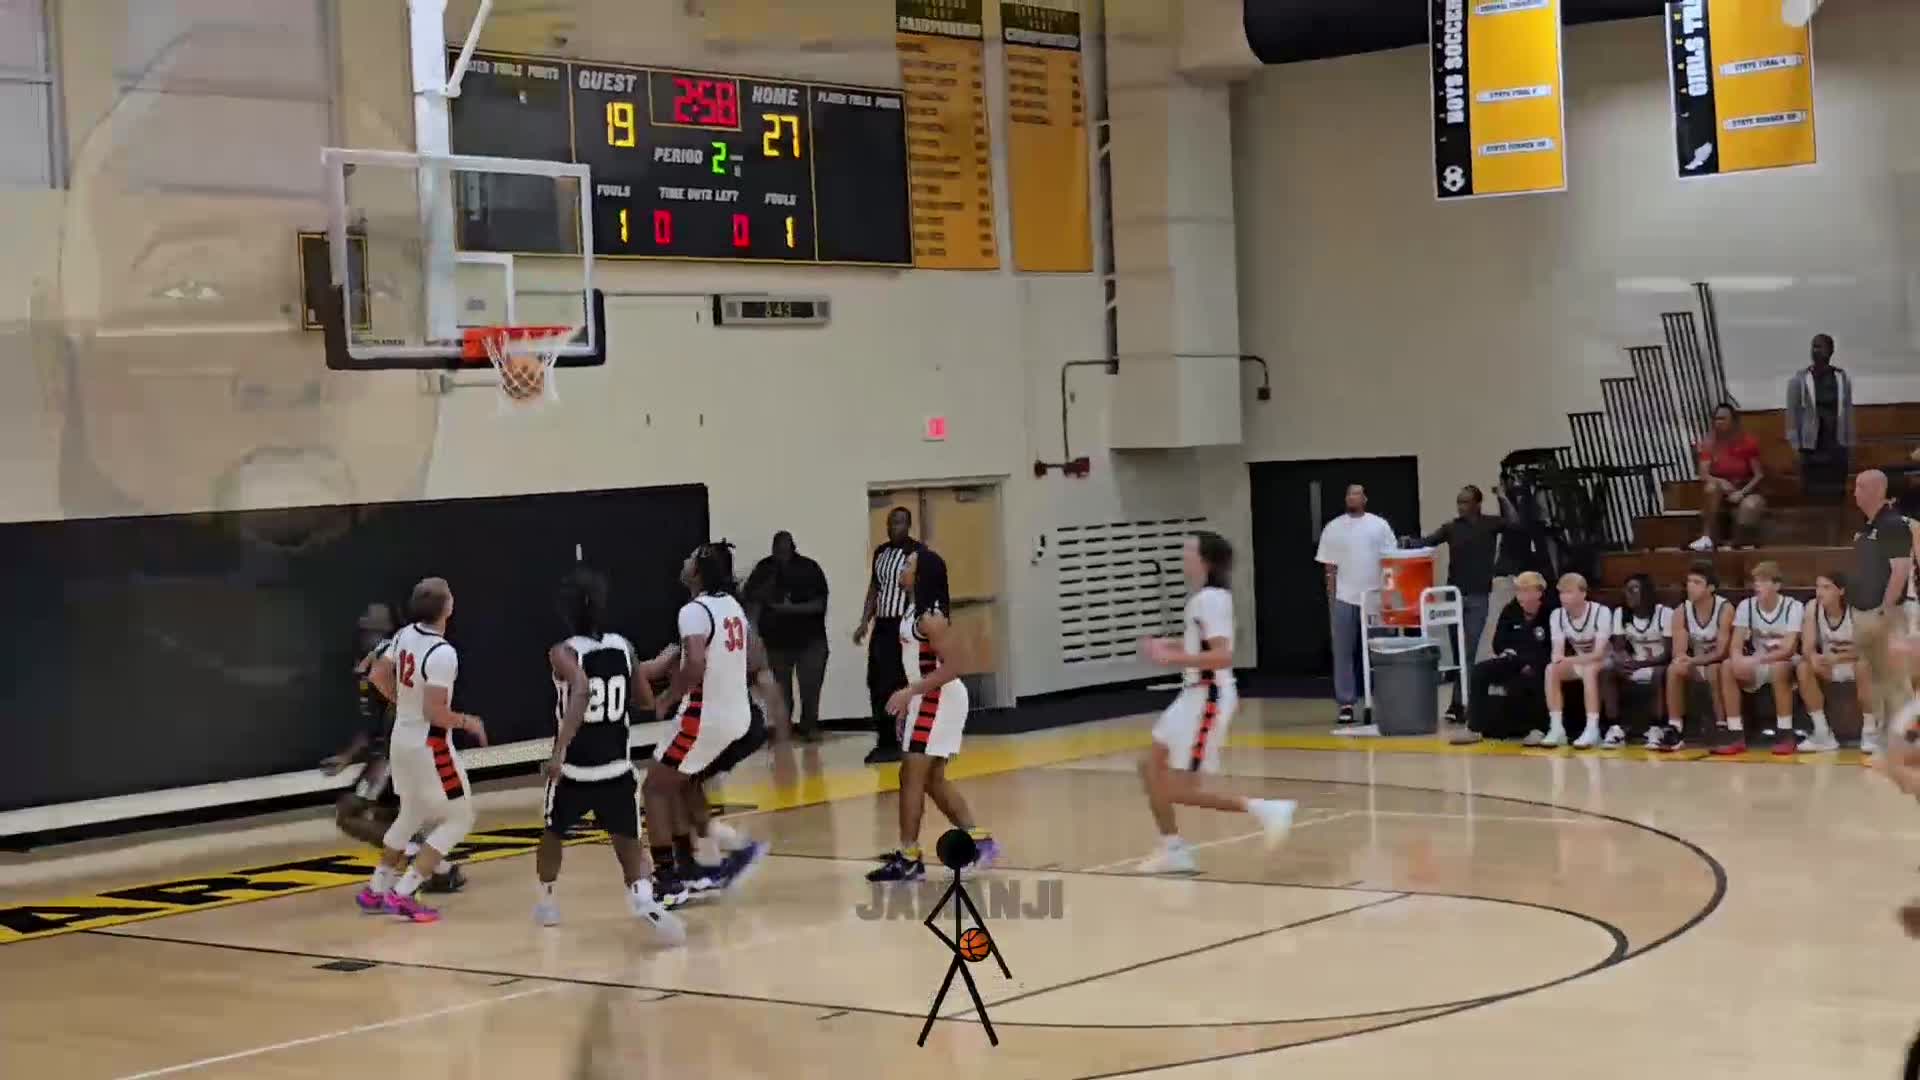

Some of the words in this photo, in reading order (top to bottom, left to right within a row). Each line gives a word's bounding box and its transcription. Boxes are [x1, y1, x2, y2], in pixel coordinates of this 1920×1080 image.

[578, 70, 637, 92] GUEST
[1684, 36, 1708, 96] GIRLS
[672, 76, 738, 127] 2:58
[752, 85, 799, 106] HOME
[607, 102, 635, 147] 19
[762, 114, 800, 158] 27
[654, 147, 703, 164] PERIOD
[712, 141, 727, 174] 2
[597, 184, 631, 197] FOULS
[659, 187, 685, 200] TIME
[687, 188, 712, 201] OUTS
[715, 189, 739, 202] LEFT
[765, 193, 797, 206] FOULS
[619, 208, 629, 243] 1
[653, 209, 672, 245] 0
[732, 213, 751, 247] 0
[785, 216, 795, 248] 1
[723, 616, 744, 651] 33
[400, 649, 415, 688] 12
[583, 674, 626, 723] 20
